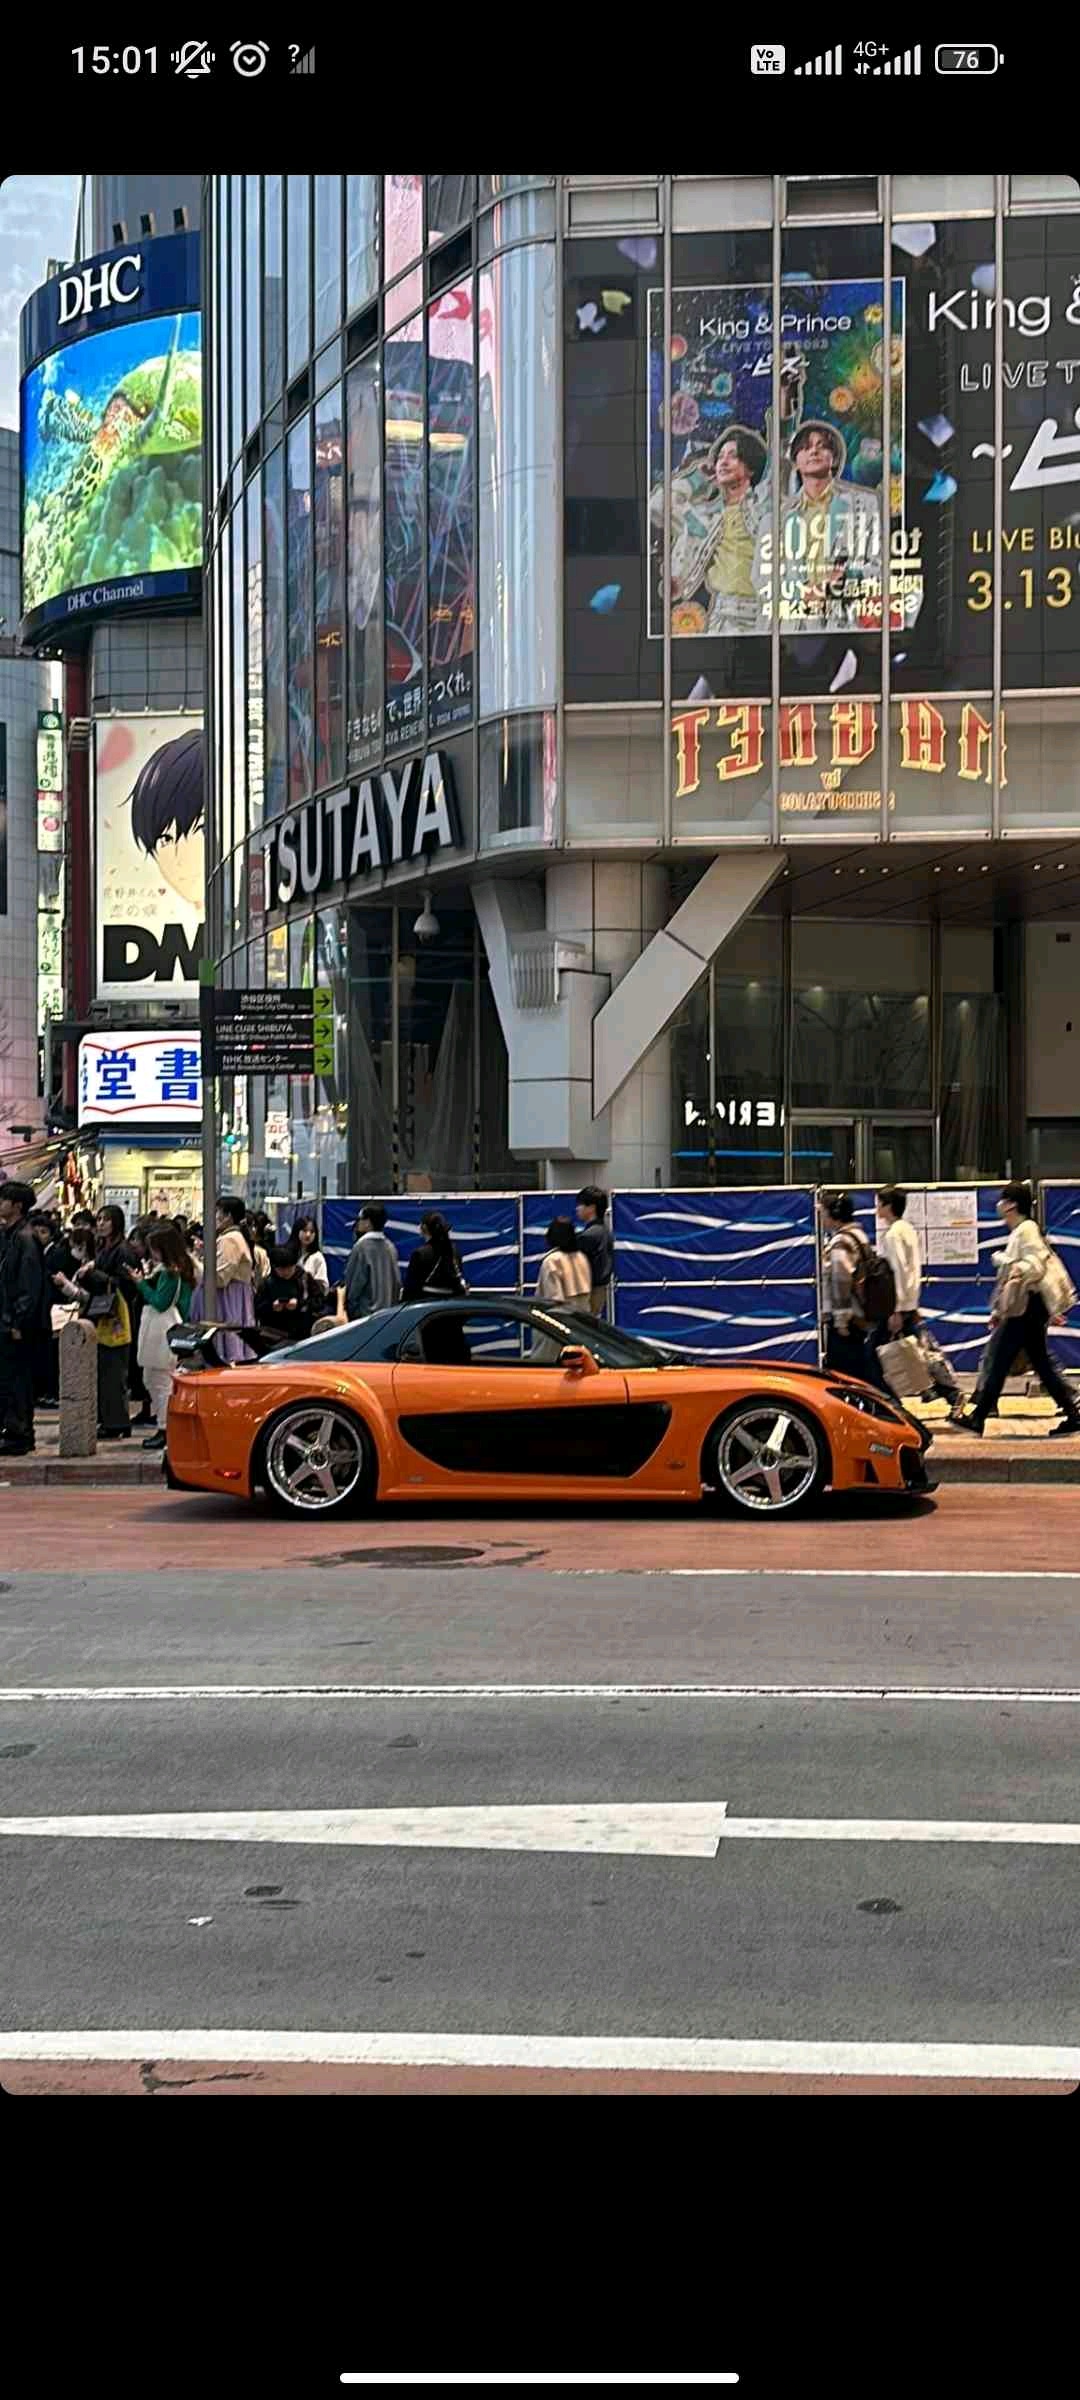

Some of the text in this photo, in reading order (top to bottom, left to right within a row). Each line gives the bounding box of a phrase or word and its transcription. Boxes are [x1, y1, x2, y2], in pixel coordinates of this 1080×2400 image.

[58, 253, 141, 325] DHC
[700, 312, 852, 339] King & Prince
[928, 289, 1050, 336] King
[960, 360, 1048, 391] LIVE
[973, 527, 1035, 553] LIVE
[67, 580, 144, 612] DHC Channel
[967, 567, 1072, 611] 3.13
[260, 752, 452, 910] TSUTAYA
[81, 1048, 202, 1102] 堂書
